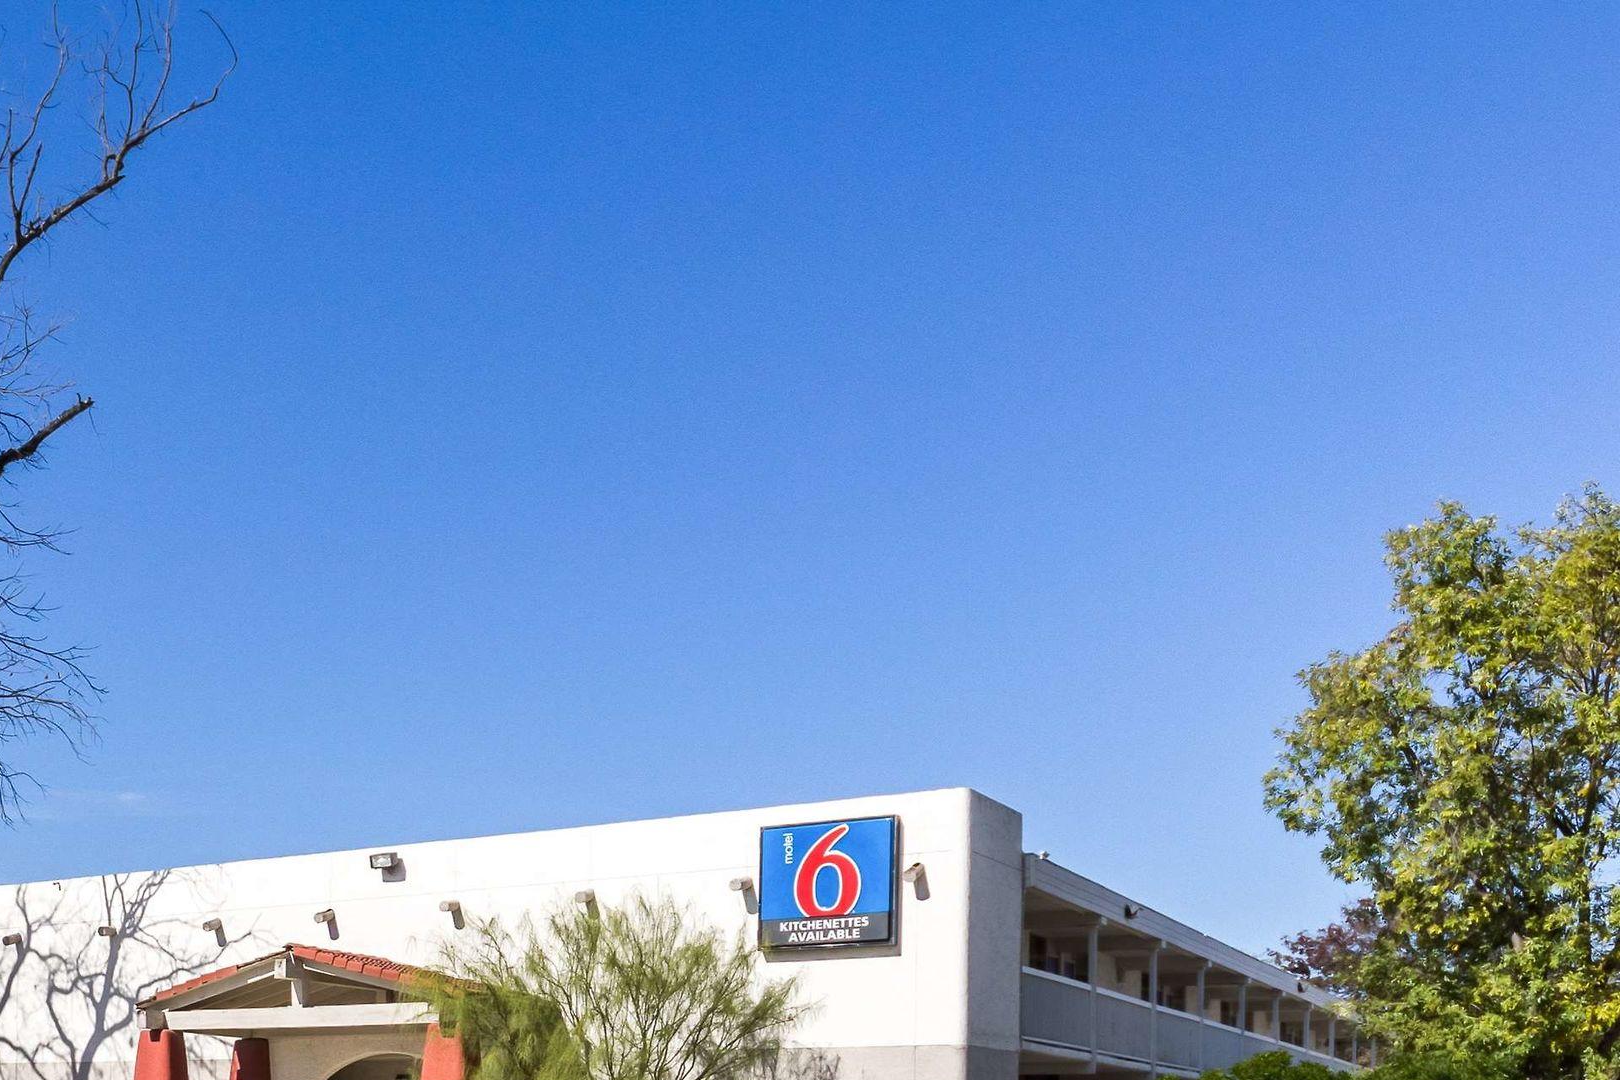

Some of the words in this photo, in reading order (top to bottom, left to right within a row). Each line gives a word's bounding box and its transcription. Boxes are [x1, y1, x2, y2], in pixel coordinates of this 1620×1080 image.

[783, 832, 794, 864] motel
[793, 823, 862, 917] 6
[779, 916, 870, 932] KITCHENETTES
[788, 928, 861, 943] AVAILABLE
